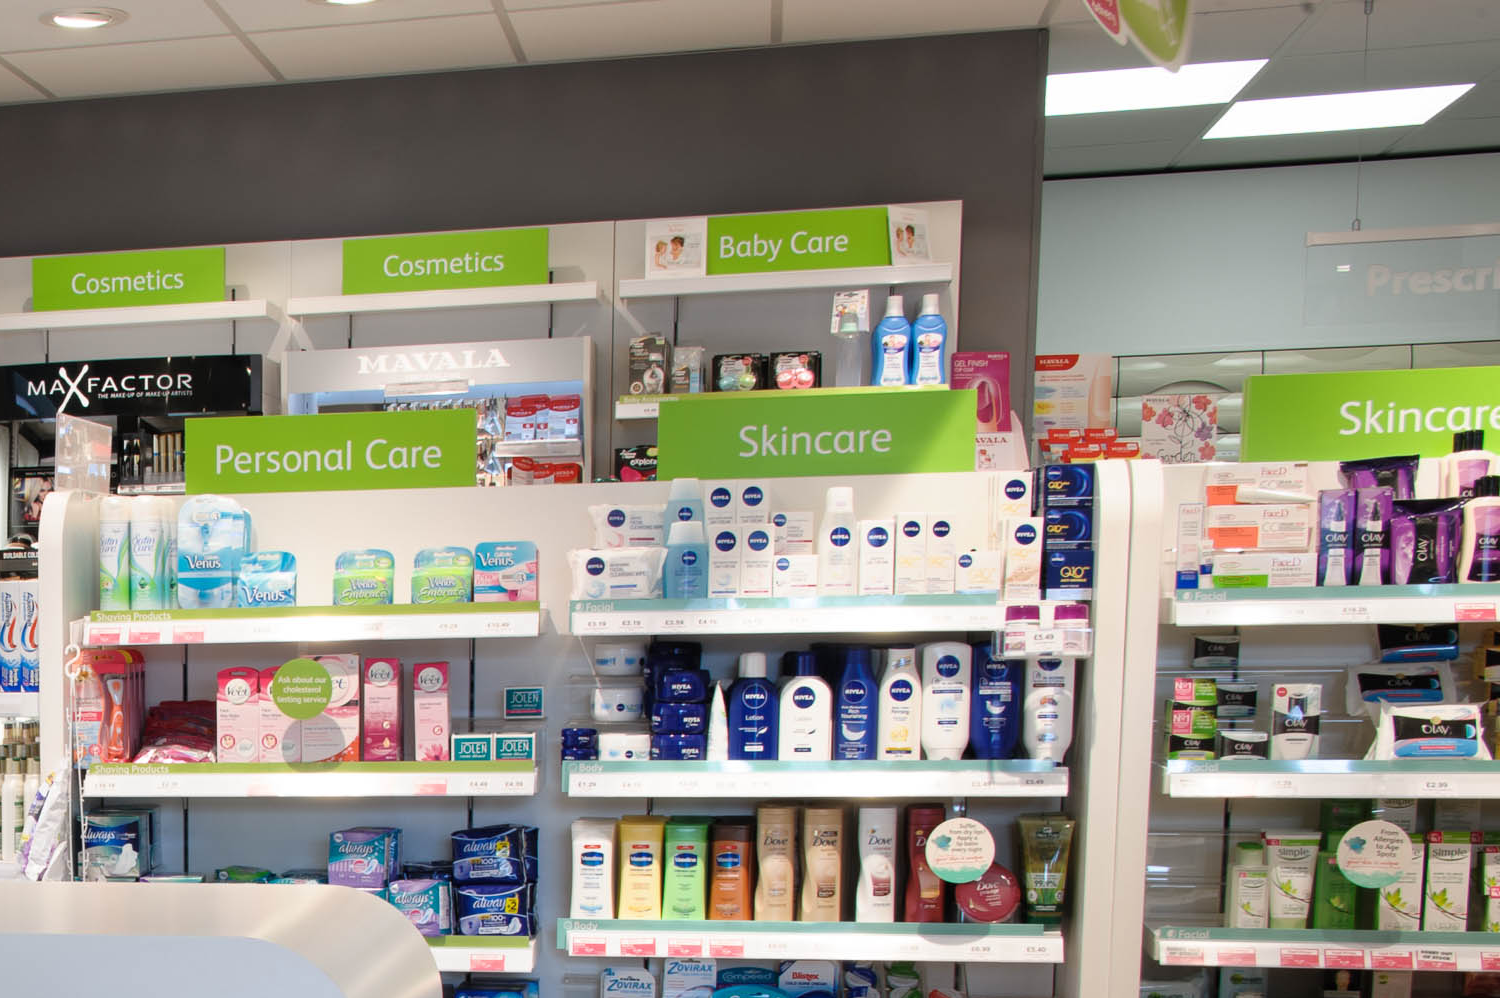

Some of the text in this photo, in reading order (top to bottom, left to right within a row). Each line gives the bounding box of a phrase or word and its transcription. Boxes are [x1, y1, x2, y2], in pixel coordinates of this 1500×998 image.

[719, 230, 849, 263] Baby Care
[383, 252, 505, 278] Cosmetics
[71, 268, 185, 296] Cosmetics
[357, 348, 510, 374] MAVALA
[145, 390, 170, 398] MAKE-UP
[170, 389, 193, 397] ARTISTS
[739, 424, 892, 459] Skincare
[215, 438, 442, 475] Personal Care
[1325, 532, 1348, 543] OLAY
[1361, 532, 1385, 543] OLAY
[1478, 536, 1499, 546] OLAY
[1417, 538, 1427, 562] OLAY
[186, 555, 221, 569] Venus
[478, 551, 515, 567] Venus
[350, 578, 378, 590] Venus
[429, 576, 455, 589] Venus
[242, 586, 286, 603] Venus
[1194, 591, 1227, 601] Facial
[584, 602, 614, 612] Facial
[95, 611, 172, 623] Shaving Products
[278, 675, 289, 684] Ask
[290, 675, 309, 684] about
[370, 669, 392, 680] Veet
[419, 674, 442, 685] Veet
[227, 684, 250, 697] Veet
[283, 685, 322, 694] cholesterol
[300, 695, 327, 704] service
[510, 693, 539, 704] JOLEN
[1421, 724, 1451, 735] OLAY
[458, 742, 487, 754] JOLEN
[500, 741, 530, 753] JOLEN
[95, 764, 169, 775] Shaving Products
[579, 763, 604, 773] Body
[1380, 828, 1399, 836] From
[763, 836, 789, 846] Dove
[812, 836, 837, 847] Dove
[868, 836, 892, 845] Dove
[1373, 836, 1405, 845] Allergies
[338, 842, 374, 855] always
[1277, 848, 1311, 858] simple
[1384, 844, 1399, 852] Age
[1432, 847, 1465, 858] simple
[1376, 850, 1397, 859] Spots
[977, 882, 998, 891] Dove
[394, 893, 429, 906] always
[473, 896, 506, 910] alway
[574, 921, 598, 930] Body
[1178, 929, 1210, 939] Facial
[667, 961, 713, 974] ZOVIRAX
[722, 971, 772, 983] Compeed
[607, 978, 652, 992] ZOVIRAX
